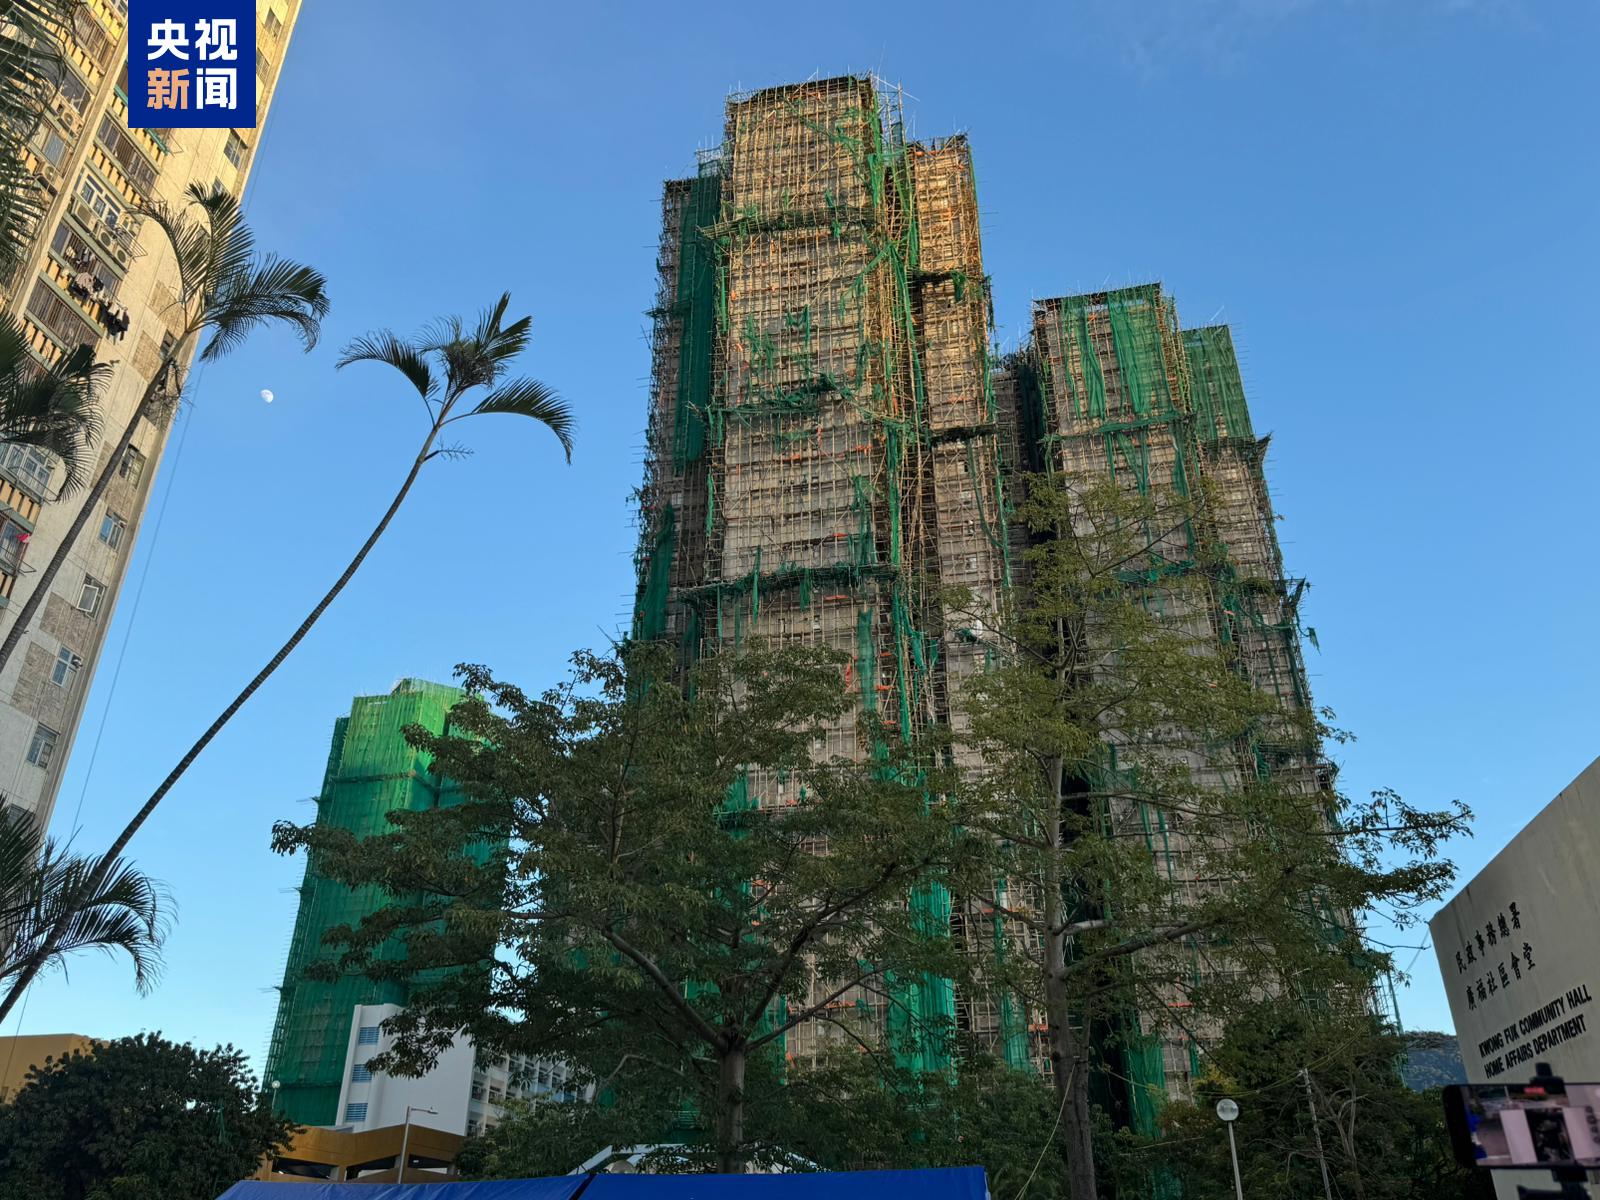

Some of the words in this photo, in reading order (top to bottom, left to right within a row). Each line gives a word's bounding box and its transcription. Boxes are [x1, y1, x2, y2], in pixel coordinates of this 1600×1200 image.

[1456, 902, 1521, 974] 民政事務總署
[1466, 943, 1535, 1010] 廣福社區會堂
[1478, 1033, 1503, 1058] KWONG
[1504, 1023, 1519, 1044] FUK
[1518, 996, 1566, 1036] COMMUNITY
[1565, 984, 1592, 1011] HALL
[1484, 1057, 1505, 1079] HOME
[1505, 1046, 1534, 1071] AFFAIRS
[1533, 1014, 1587, 1055] DEPARTMENT
